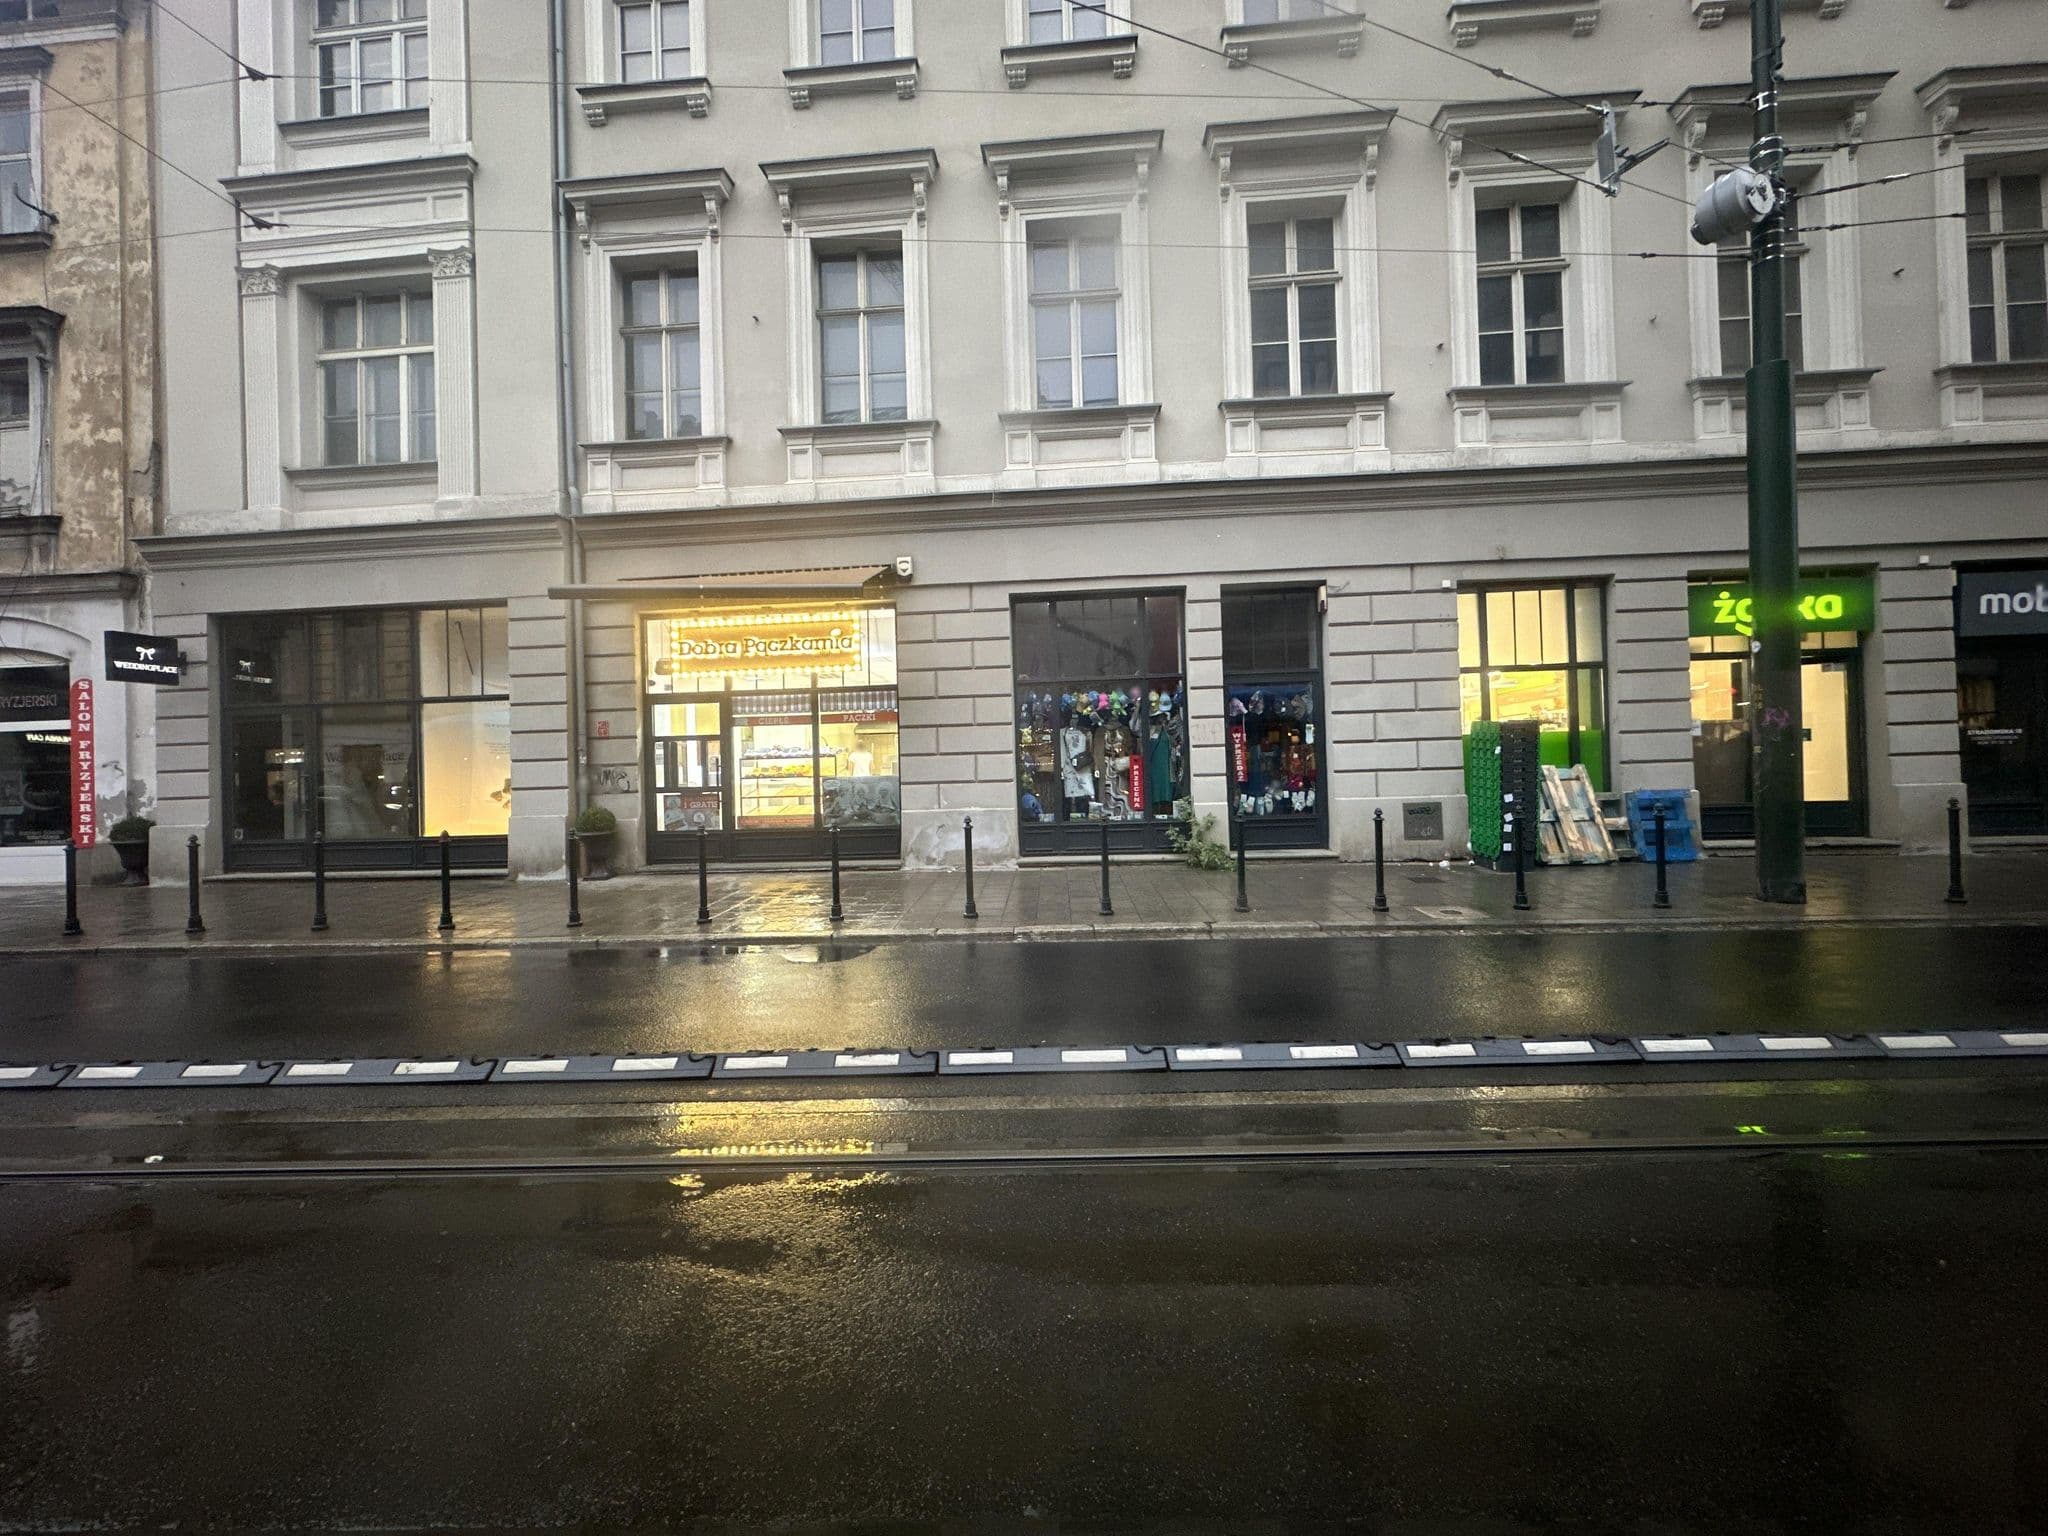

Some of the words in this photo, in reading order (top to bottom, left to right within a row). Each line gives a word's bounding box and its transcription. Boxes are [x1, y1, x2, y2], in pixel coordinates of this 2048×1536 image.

[679, 640, 738, 656] Dobra
[78, 680, 91, 732] SALON
[79, 740, 93, 844] FRYZJERSKI
